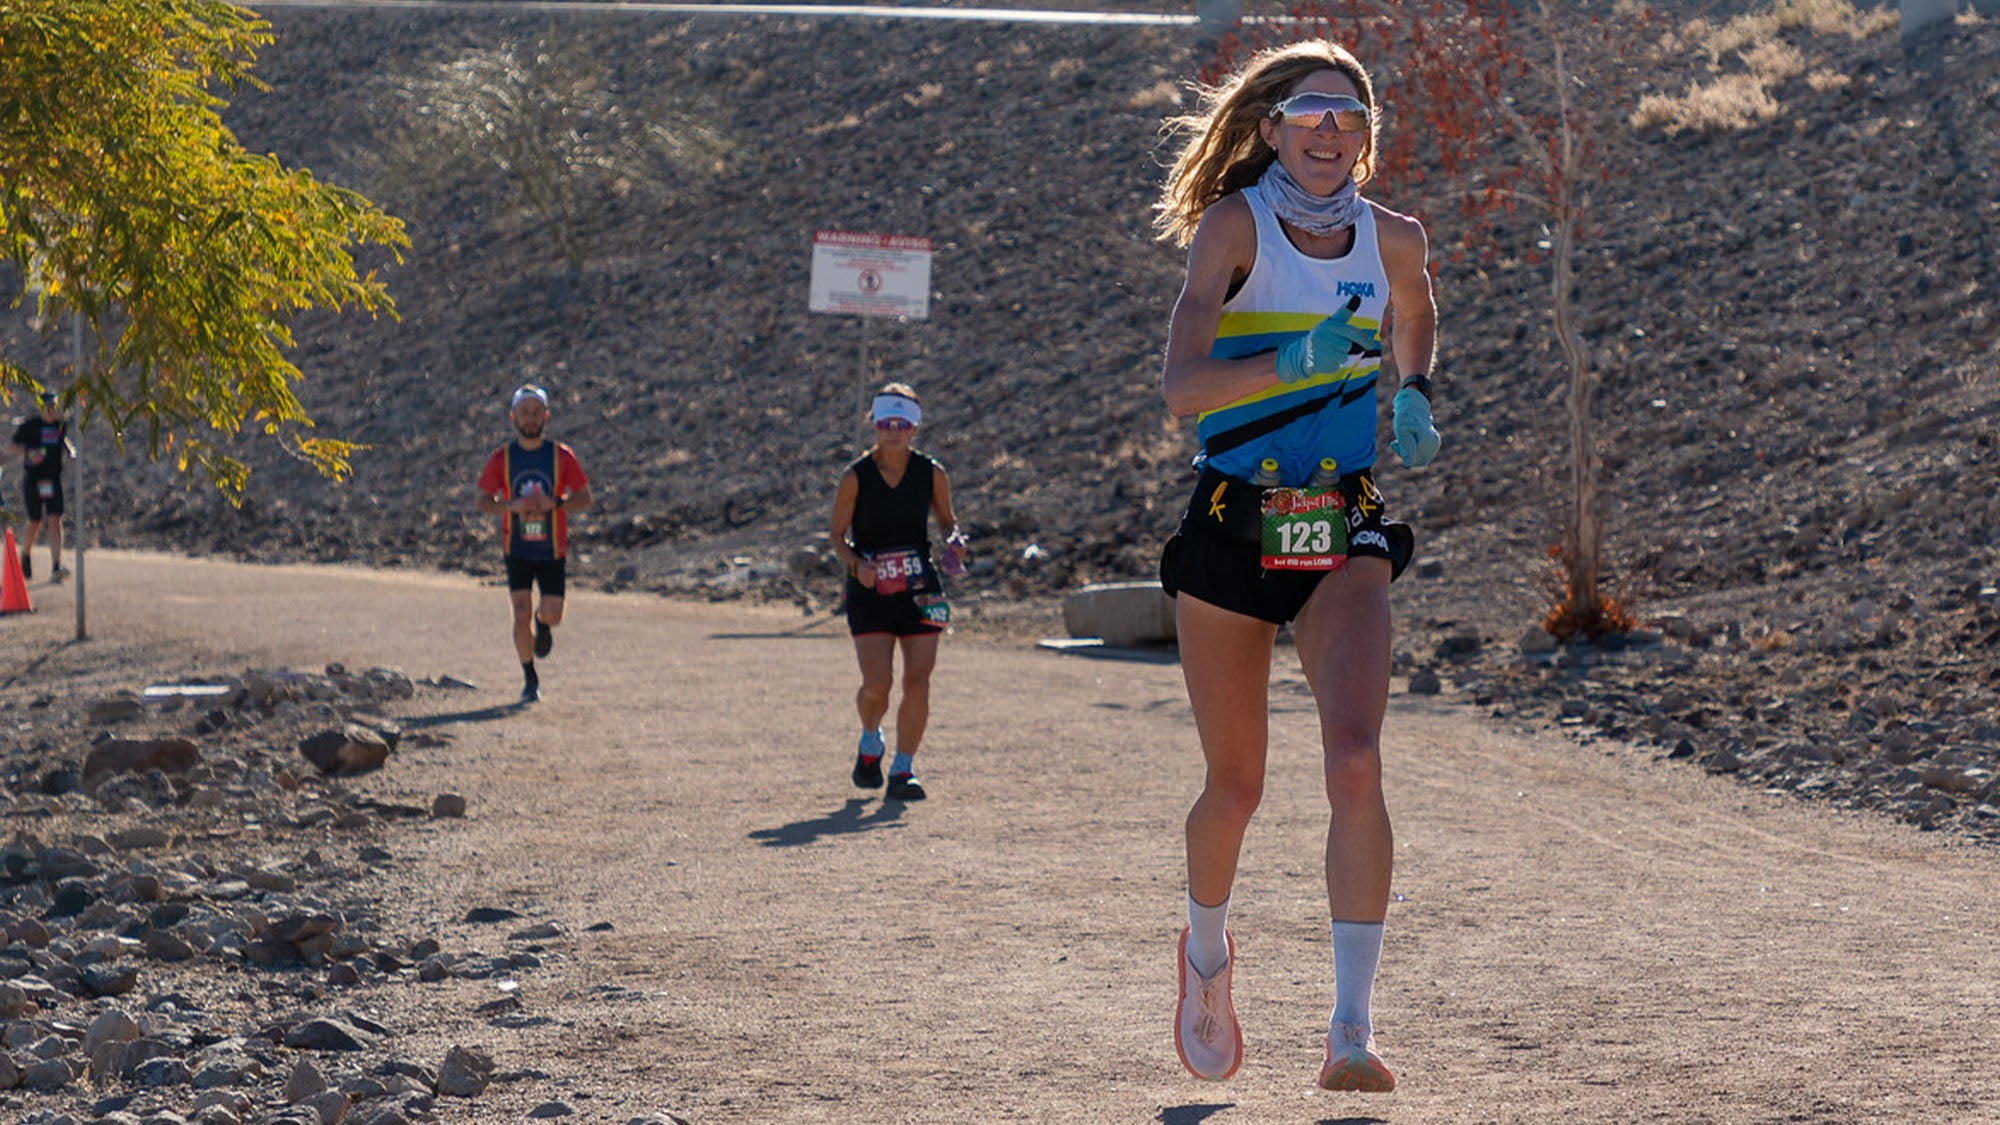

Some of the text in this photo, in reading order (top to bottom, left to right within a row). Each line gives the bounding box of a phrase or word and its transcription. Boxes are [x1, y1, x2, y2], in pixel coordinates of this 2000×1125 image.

[816, 230, 881, 245] WARNING
[1336, 281, 1376, 298] HOKA
[1276, 520, 1332, 553] 123
[1300, 559, 1312, 567] run
